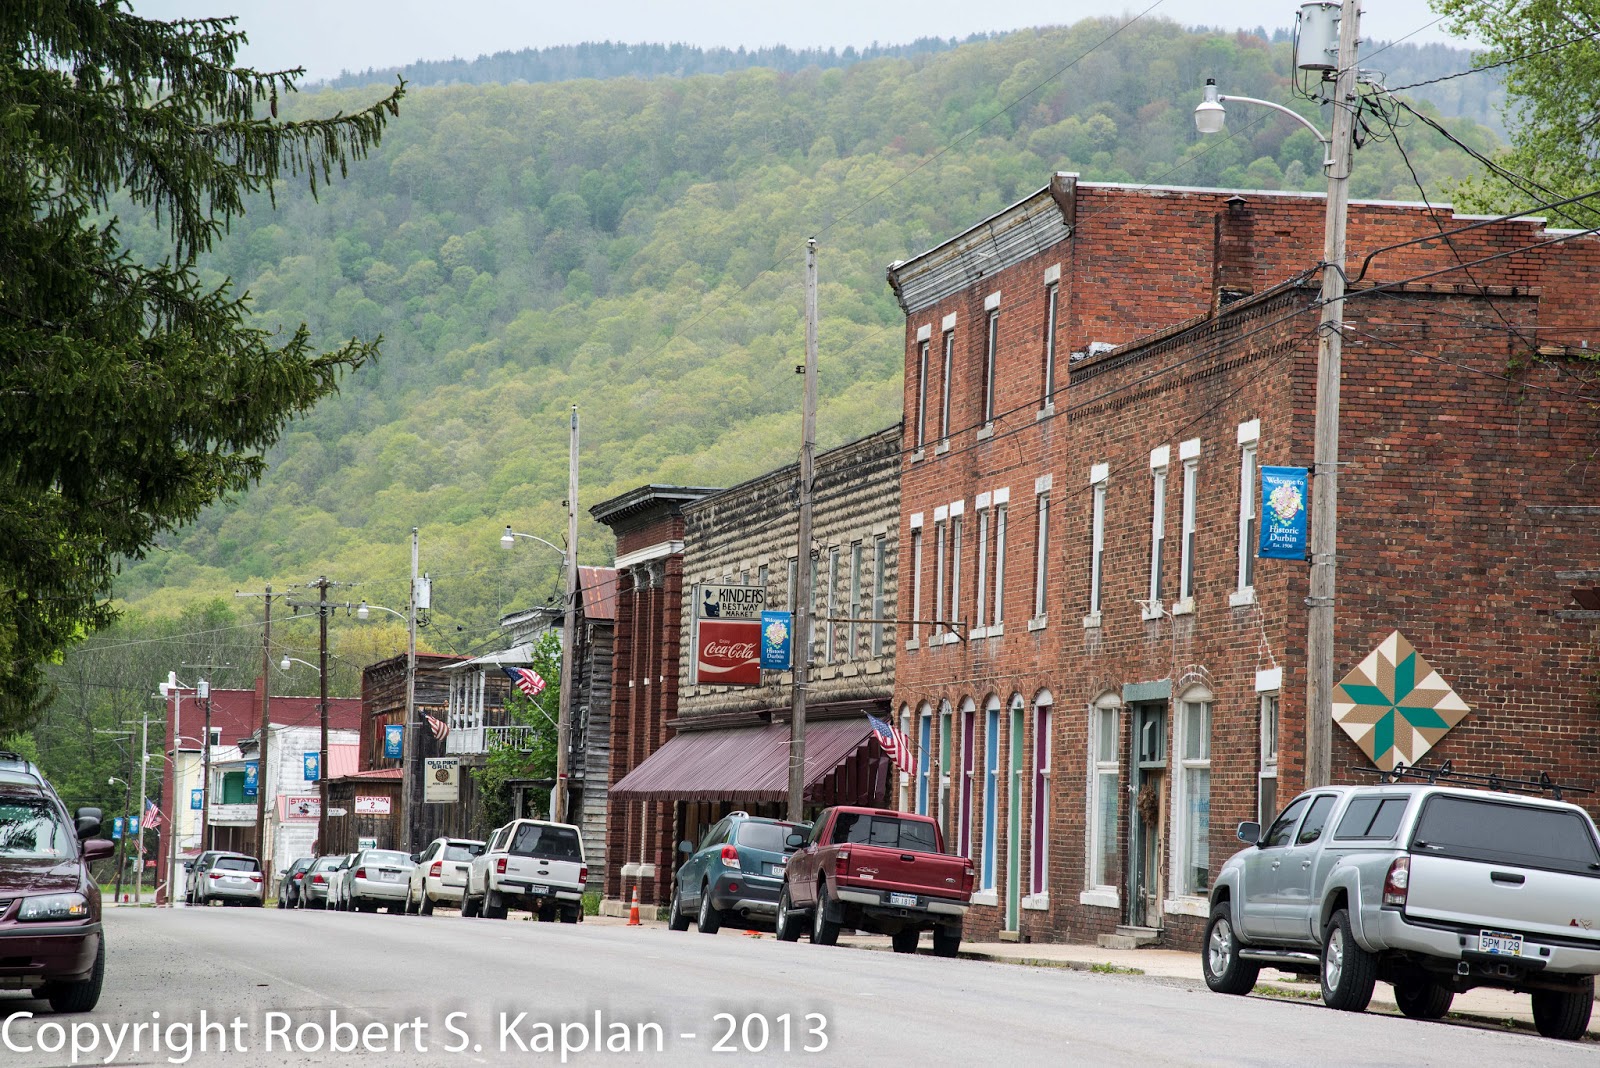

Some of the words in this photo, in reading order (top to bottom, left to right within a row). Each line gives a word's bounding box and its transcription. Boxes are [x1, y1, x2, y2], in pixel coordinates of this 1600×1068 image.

[1266, 476, 1296, 485] Welcome
[1269, 525, 1299, 535] Historic
[1269, 533, 1297, 543] Durbin
[719, 588, 764, 604] KINDER'S
[722, 603, 759, 611] BESTWAY
[703, 641, 757, 659] Coca-Cola
[1482, 937, 1500, 949] 5PM
[1503, 940, 1520, 951] 129
